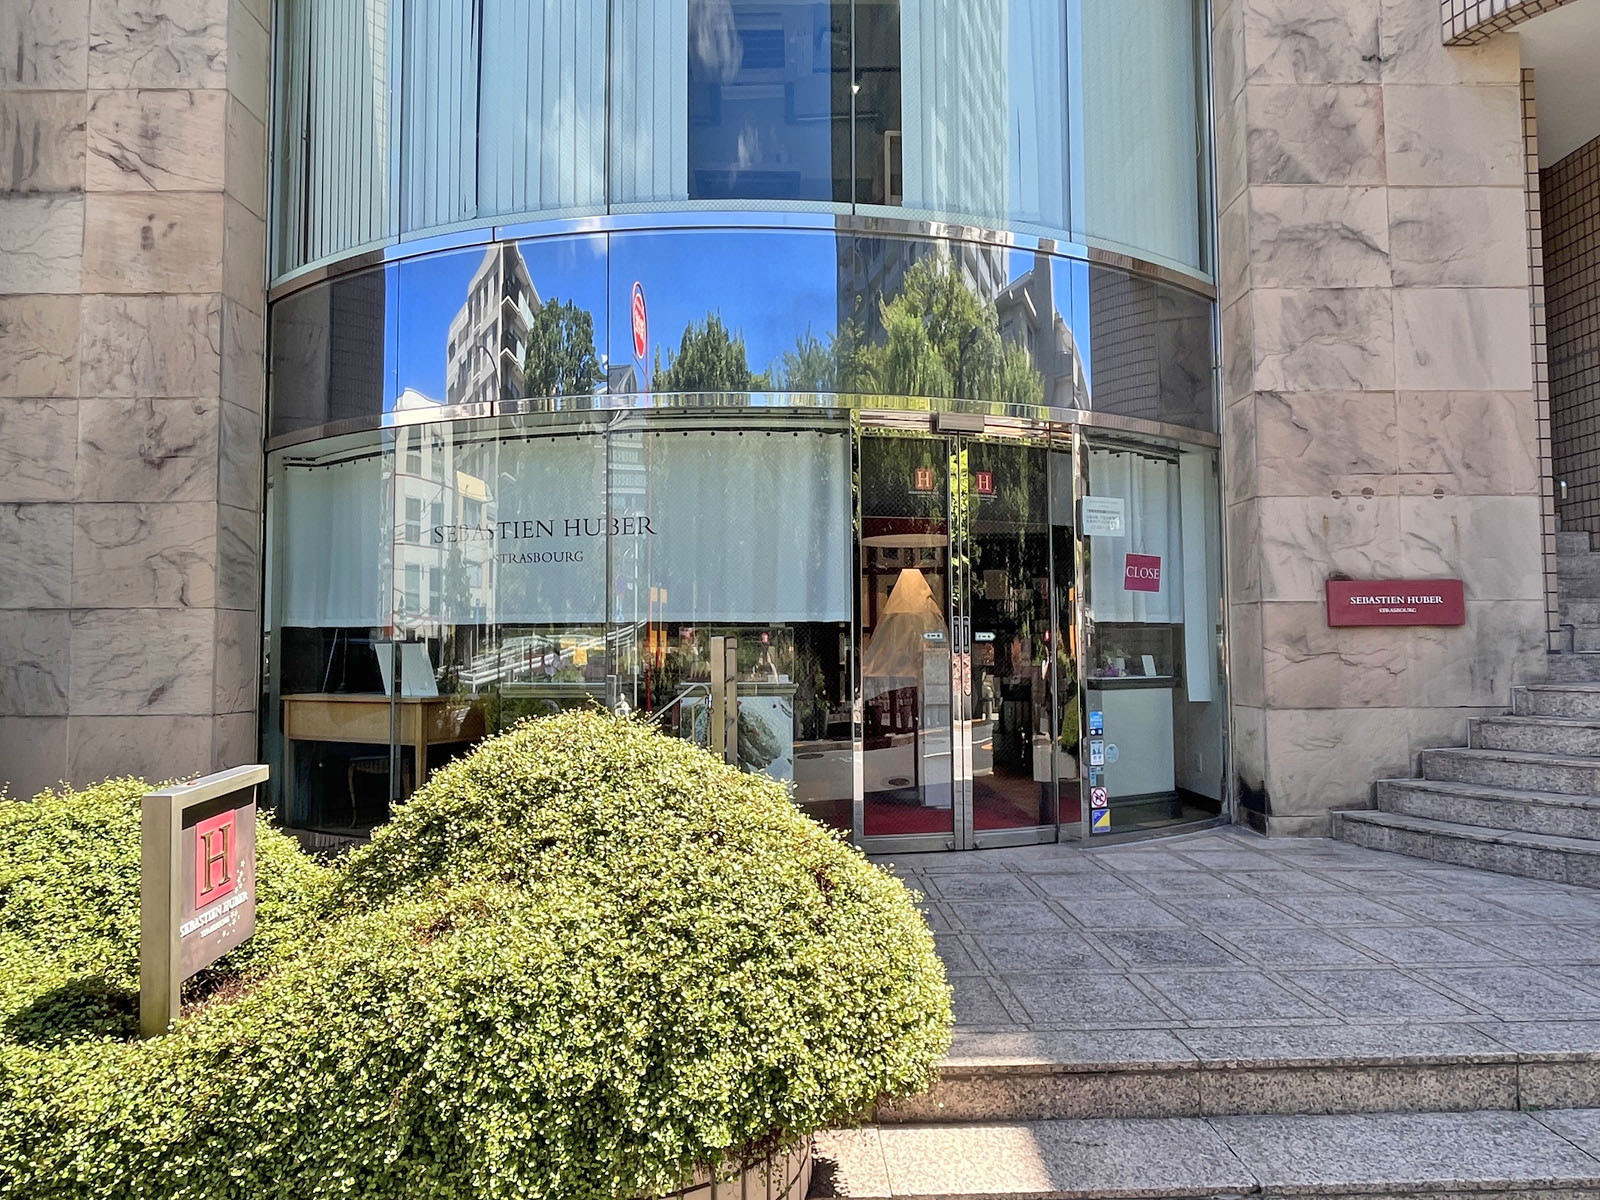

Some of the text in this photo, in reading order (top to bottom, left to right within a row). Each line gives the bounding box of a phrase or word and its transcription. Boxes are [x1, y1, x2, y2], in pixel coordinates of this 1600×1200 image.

[917, 471, 930, 488] H
[978, 474, 990, 491] H
[434, 516, 657, 544] SEBASTIEN HUBER
[492, 551, 584, 564] STRASBOURG
[1126, 566, 1159, 579] CLOSE
[1350, 595, 1444, 605] SEBASTIEN HUBER
[201, 822, 232, 897] H
